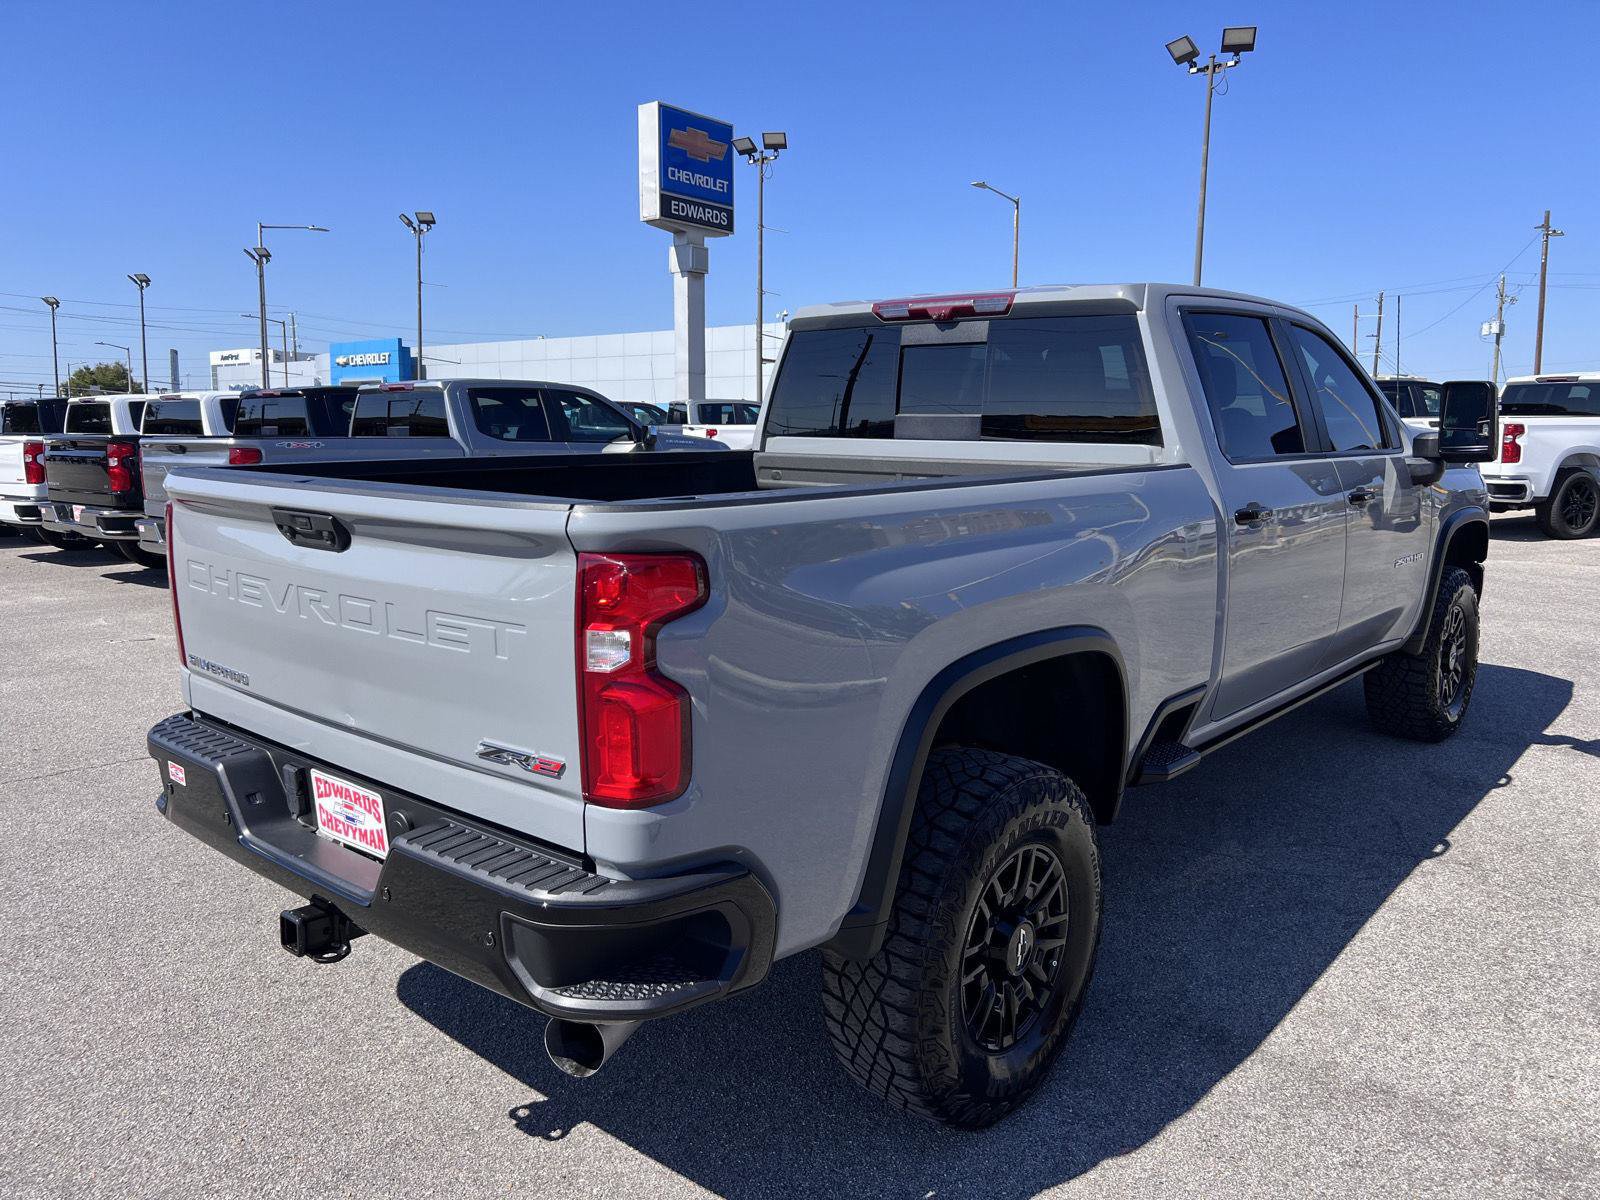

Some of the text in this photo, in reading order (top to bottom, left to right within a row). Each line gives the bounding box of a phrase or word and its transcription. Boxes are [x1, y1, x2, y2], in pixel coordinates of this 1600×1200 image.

[668, 166, 728, 193] CHEVROLET
[671, 200, 728, 226] EDWARDS
[349, 352, 392, 367] CHEVROLET
[186, 559, 528, 660] CHEVROLET
[188, 653, 250, 687] SILVERADO
[314, 776, 382, 824] EDWARDS
[318, 802, 386, 852] CHEVYMAN
